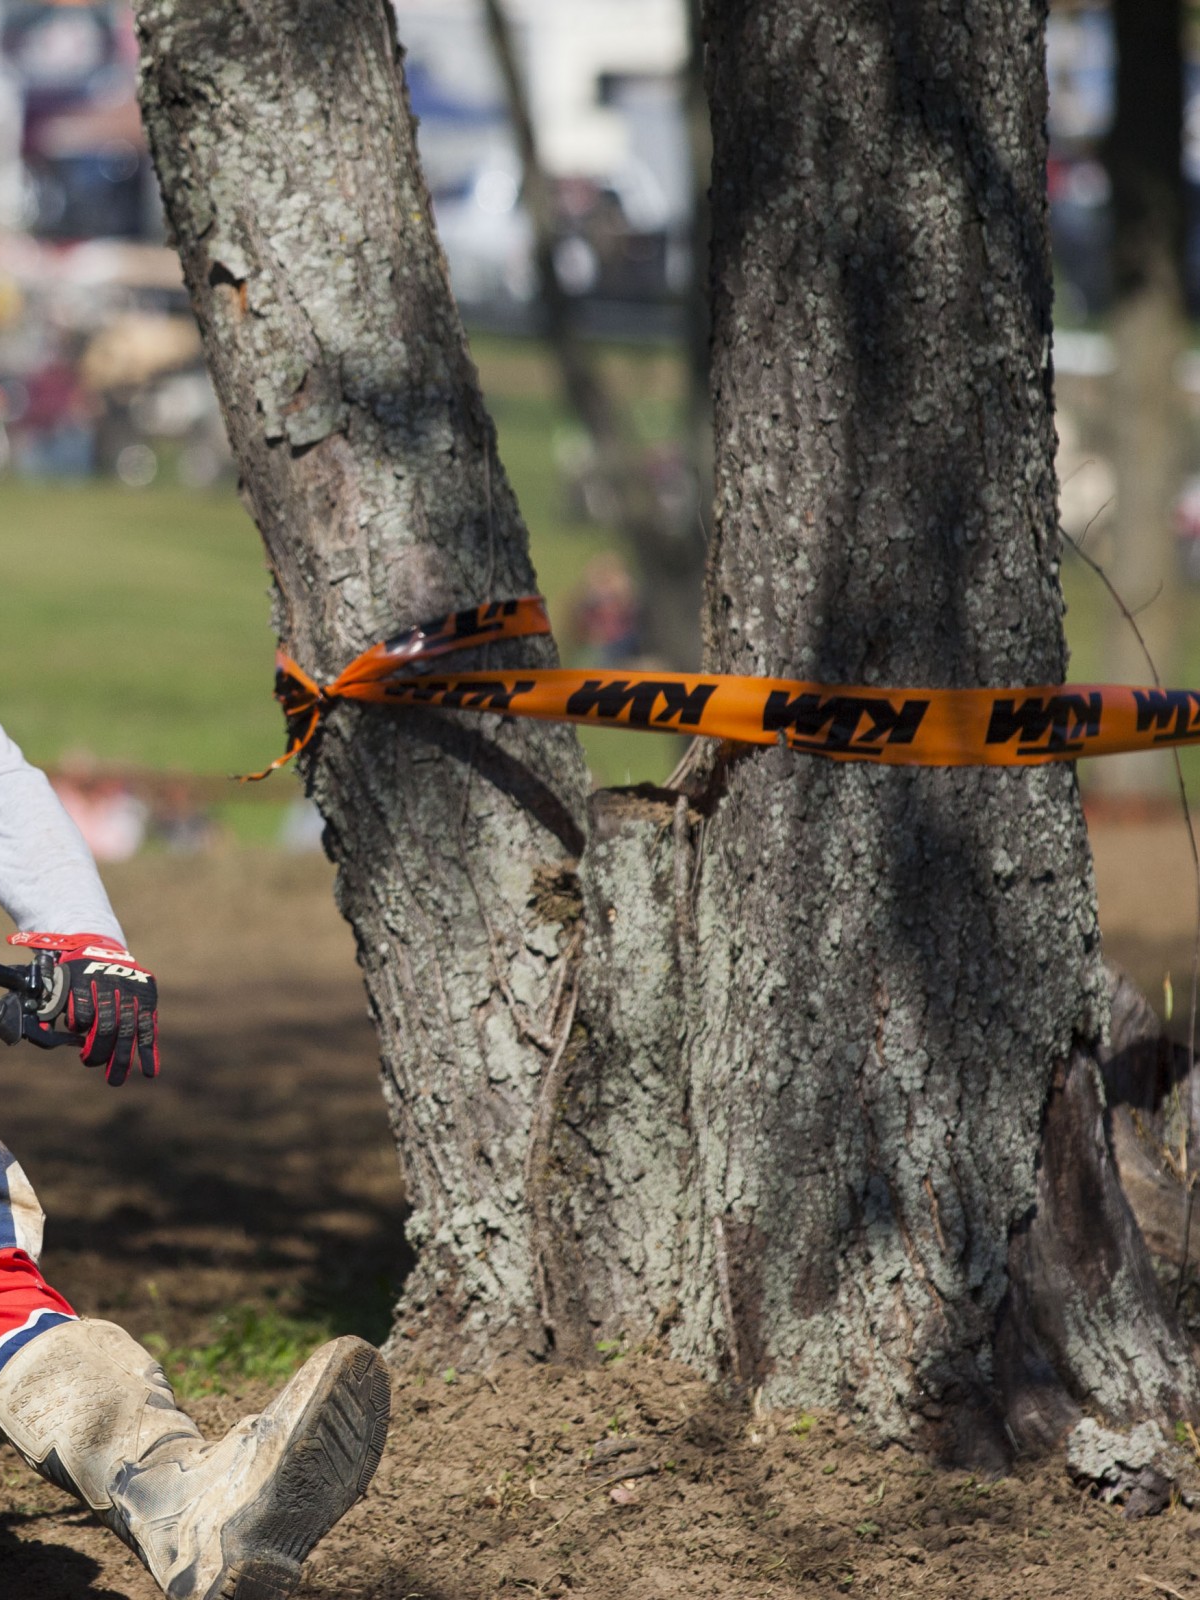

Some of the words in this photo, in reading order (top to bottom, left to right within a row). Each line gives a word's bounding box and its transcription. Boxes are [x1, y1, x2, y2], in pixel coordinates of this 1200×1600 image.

[762, 689, 931, 755] KTM
[985, 691, 1103, 756] KTM
[83, 962, 152, 984] FOX
